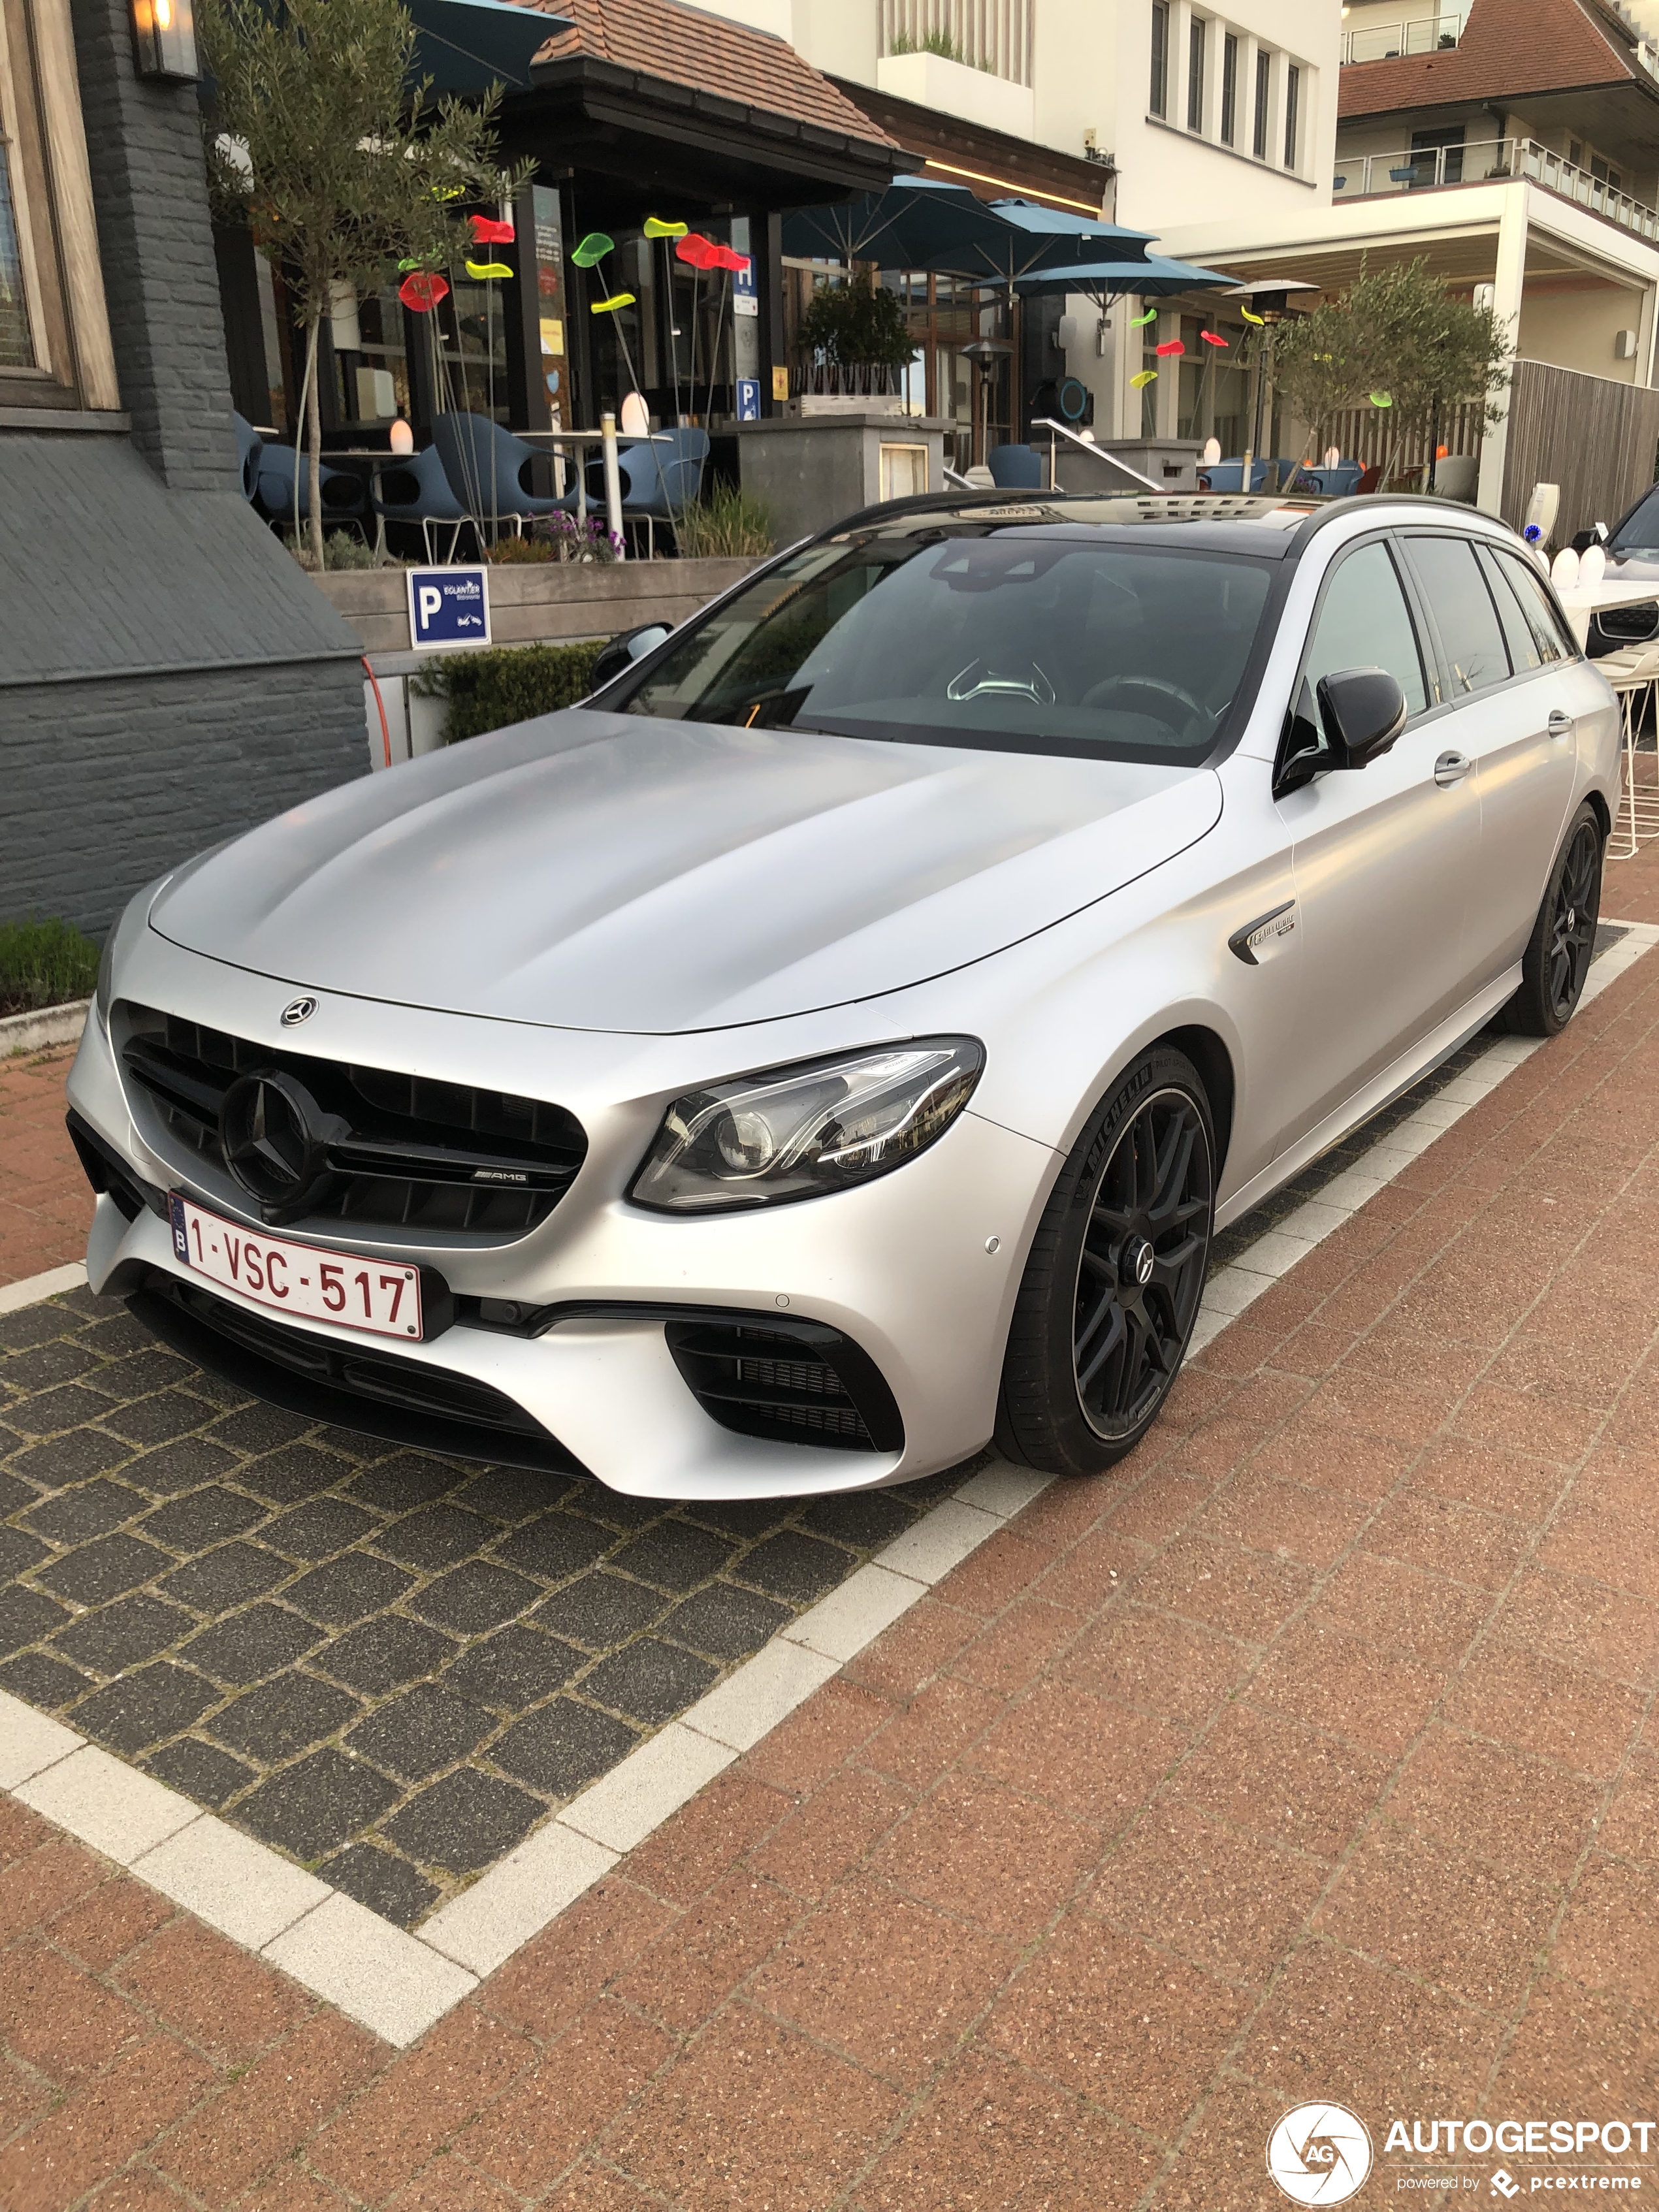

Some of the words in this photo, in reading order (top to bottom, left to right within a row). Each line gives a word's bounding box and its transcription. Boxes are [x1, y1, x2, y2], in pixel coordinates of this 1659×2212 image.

[743, 384, 754, 406] P
[419, 586, 442, 630] P
[1087, 1066, 1152, 1172] MICHELIN
[1156, 1058, 1171, 1070] PILOT
[491, 1172, 526, 1181] AMG
[175, 1230, 186, 1253] B
[191, 1218, 405, 1323] 1-VSC-517
